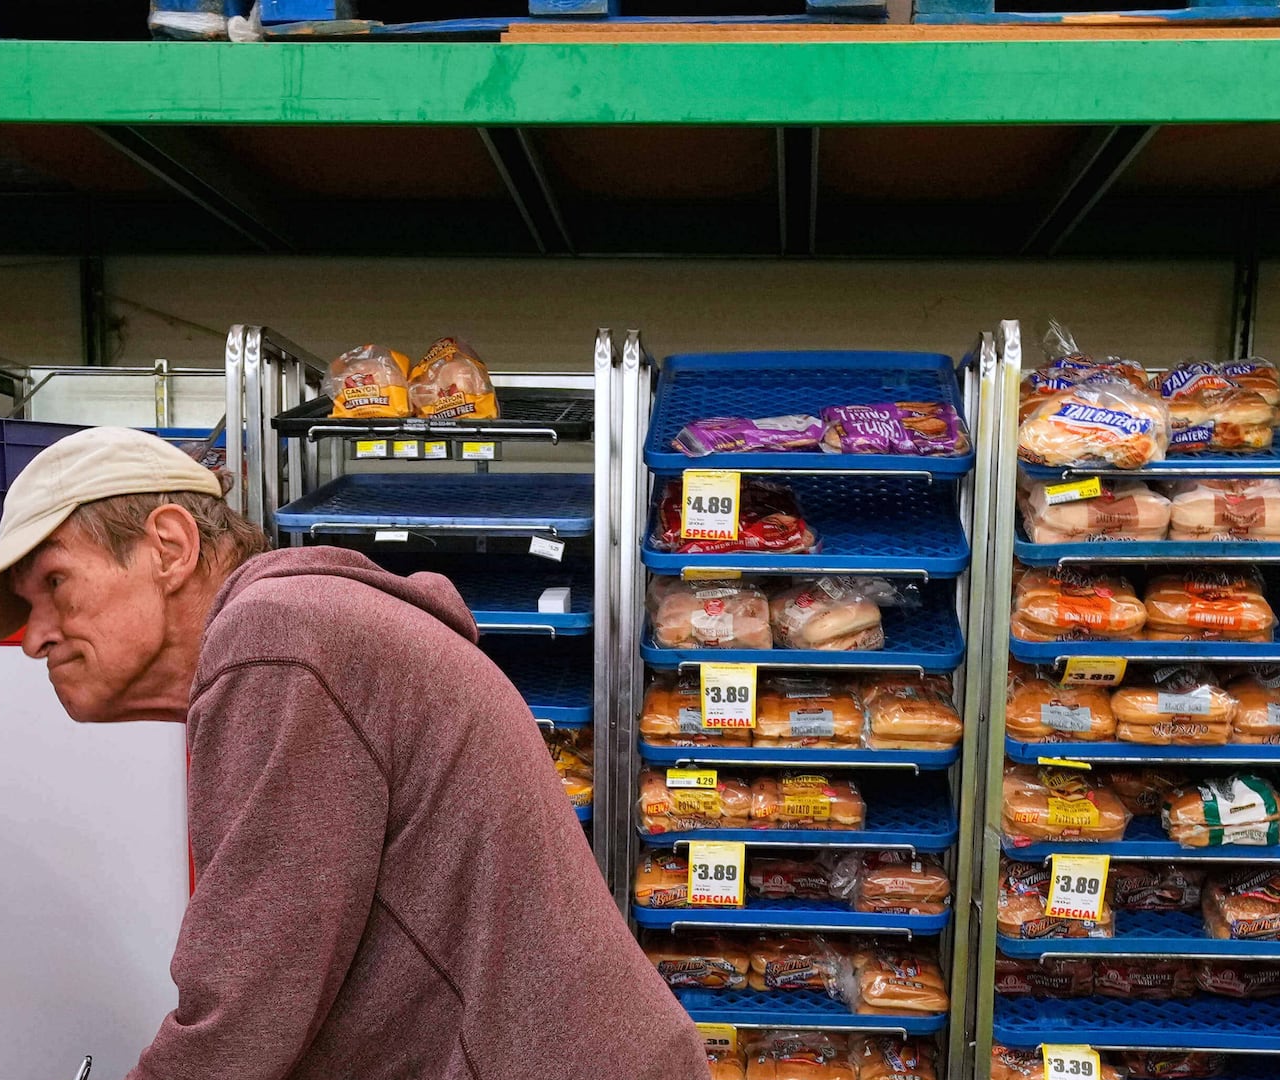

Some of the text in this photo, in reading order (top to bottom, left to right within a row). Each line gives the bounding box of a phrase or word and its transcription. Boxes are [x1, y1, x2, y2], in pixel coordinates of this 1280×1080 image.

[456, 403, 475, 415] FREE
[1064, 404, 1145, 434] TAILGATERS
[686, 496, 733, 515] $4.89
[685, 529, 734, 540] SPECIAL
[705, 686, 750, 704] $3.89
[706, 718, 752, 727] SPECIAL
[696, 777, 714, 786] 4.29
[786, 804, 810, 815] POTATO
[1015, 812, 1040, 824] NEW!
[692, 864, 738, 882] $3.89
[1055, 874, 1101, 896] $3.89
[691, 894, 739, 905] SPECIAL
[1049, 906, 1097, 920] SPECIAL
[1047, 1057, 1094, 1077] $3.39
